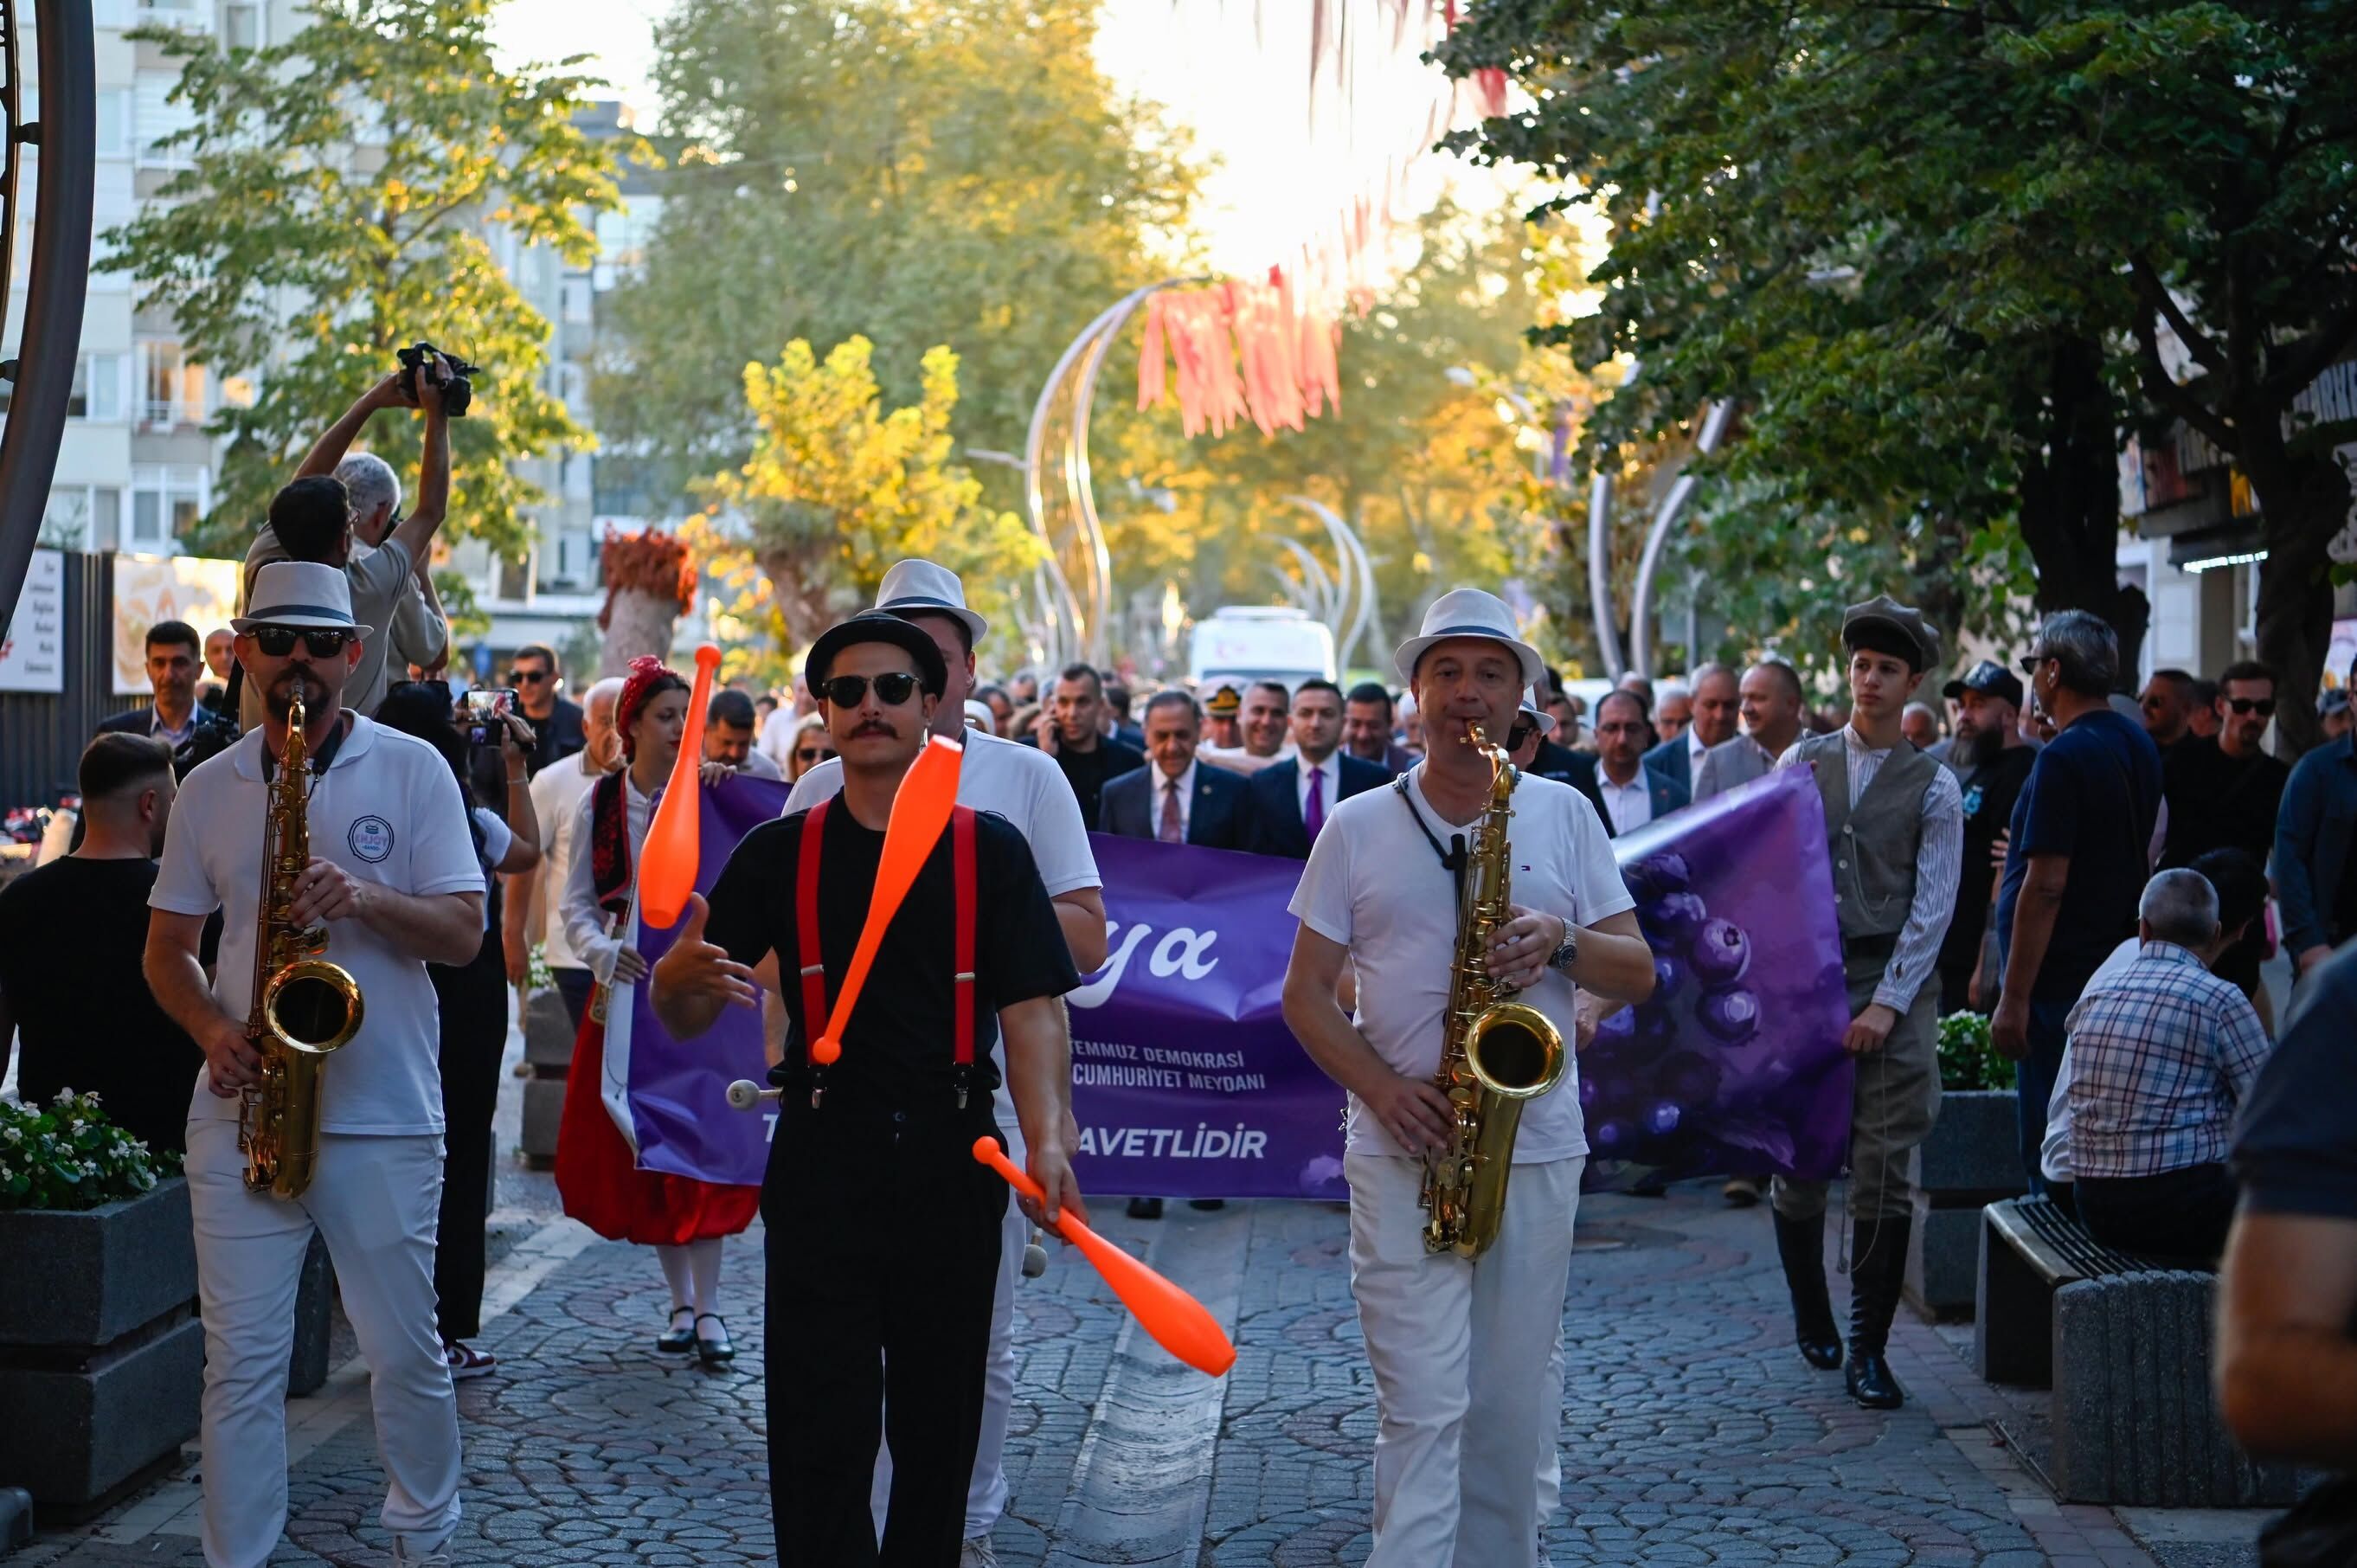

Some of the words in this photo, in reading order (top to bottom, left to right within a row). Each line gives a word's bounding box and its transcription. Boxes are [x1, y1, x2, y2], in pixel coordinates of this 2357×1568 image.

[1065, 920, 1219, 1009] ya
[1143, 1047, 1244, 1069] DEMOKRASİ
[1073, 1064, 1182, 1088] CUMHURİYET
[1188, 1072, 1266, 1092] MEYDANI
[1079, 1121, 1268, 1159] AVETLİDİR
